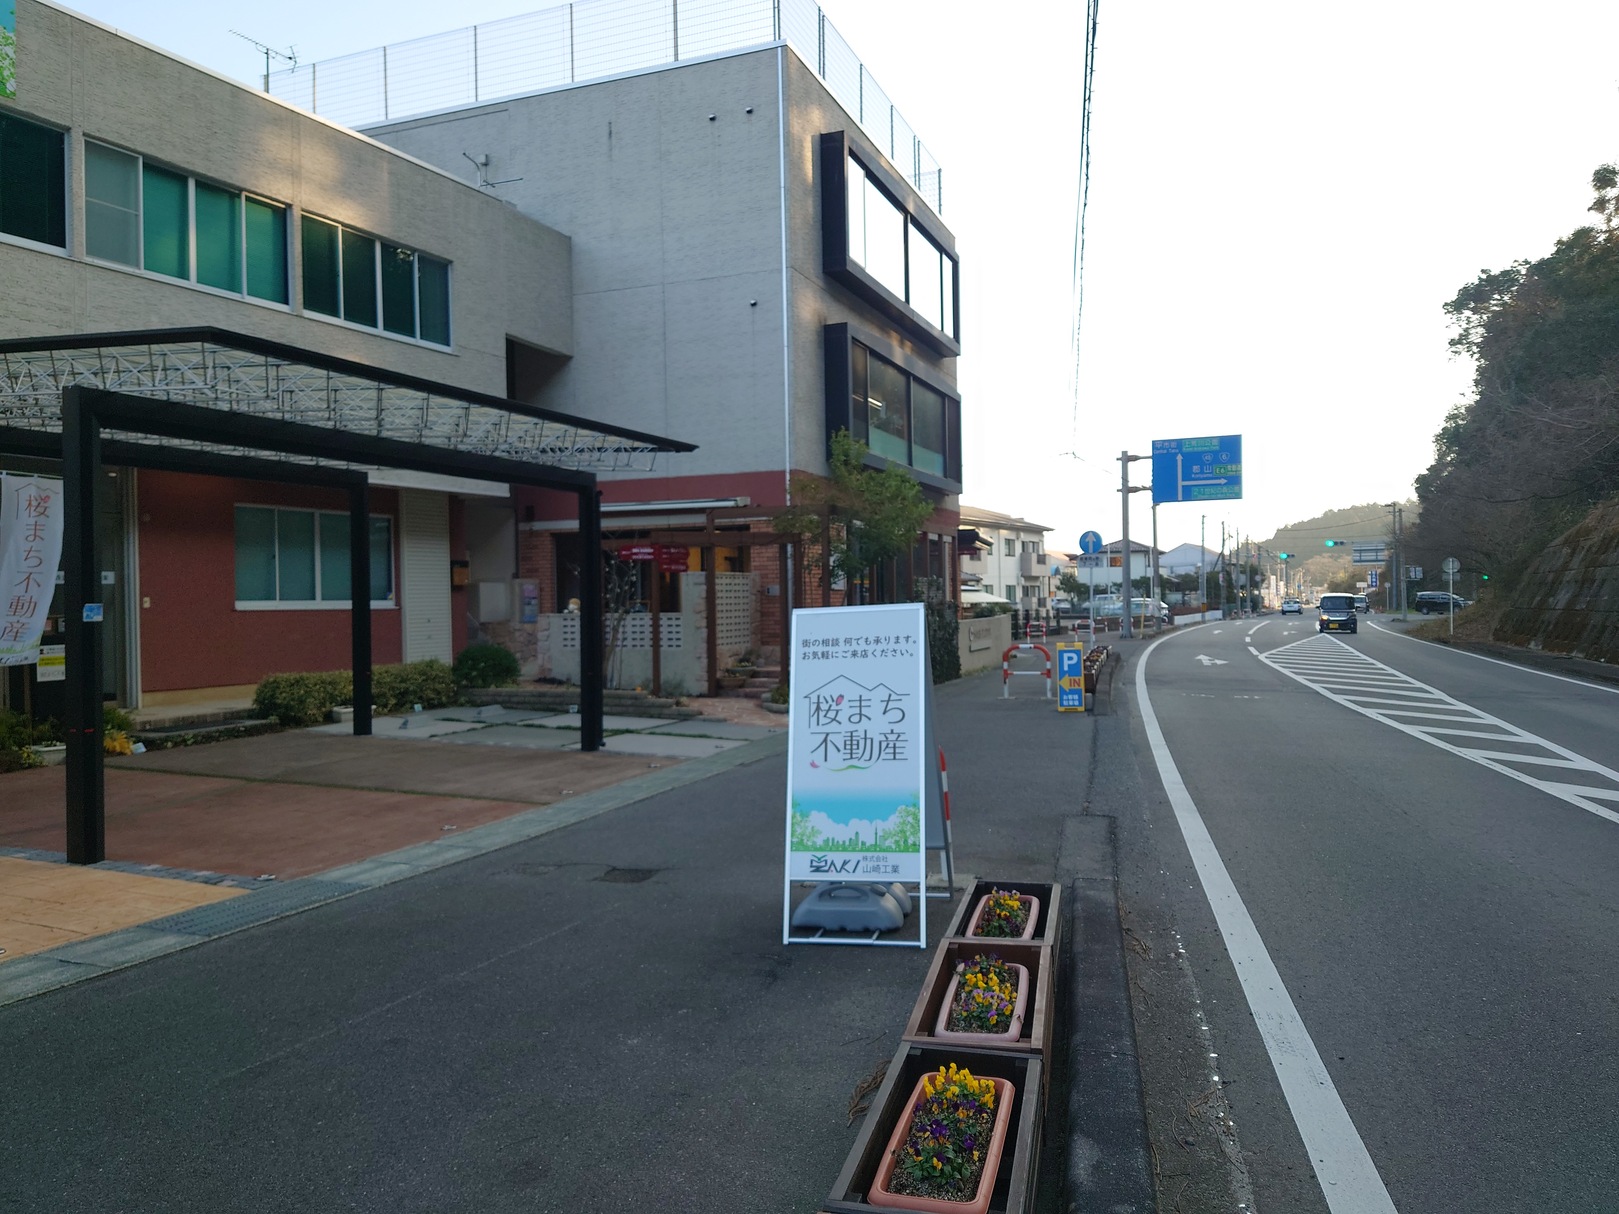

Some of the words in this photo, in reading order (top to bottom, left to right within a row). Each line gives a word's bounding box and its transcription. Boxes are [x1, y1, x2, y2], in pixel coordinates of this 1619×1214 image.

[0, 494, 50, 643] 桜まち不動産
[802, 638, 841, 648] 街の相談
[843, 635, 917, 647] 何でも承ります。
[802, 648, 914, 661] お気軽にご来店ください。
[1063, 652, 1078, 671] P
[1069, 678, 1081, 688] IN
[811, 693, 906, 727] 桜まち
[810, 728, 909, 763] 不動産
[862, 854, 889, 863] 株式会社
